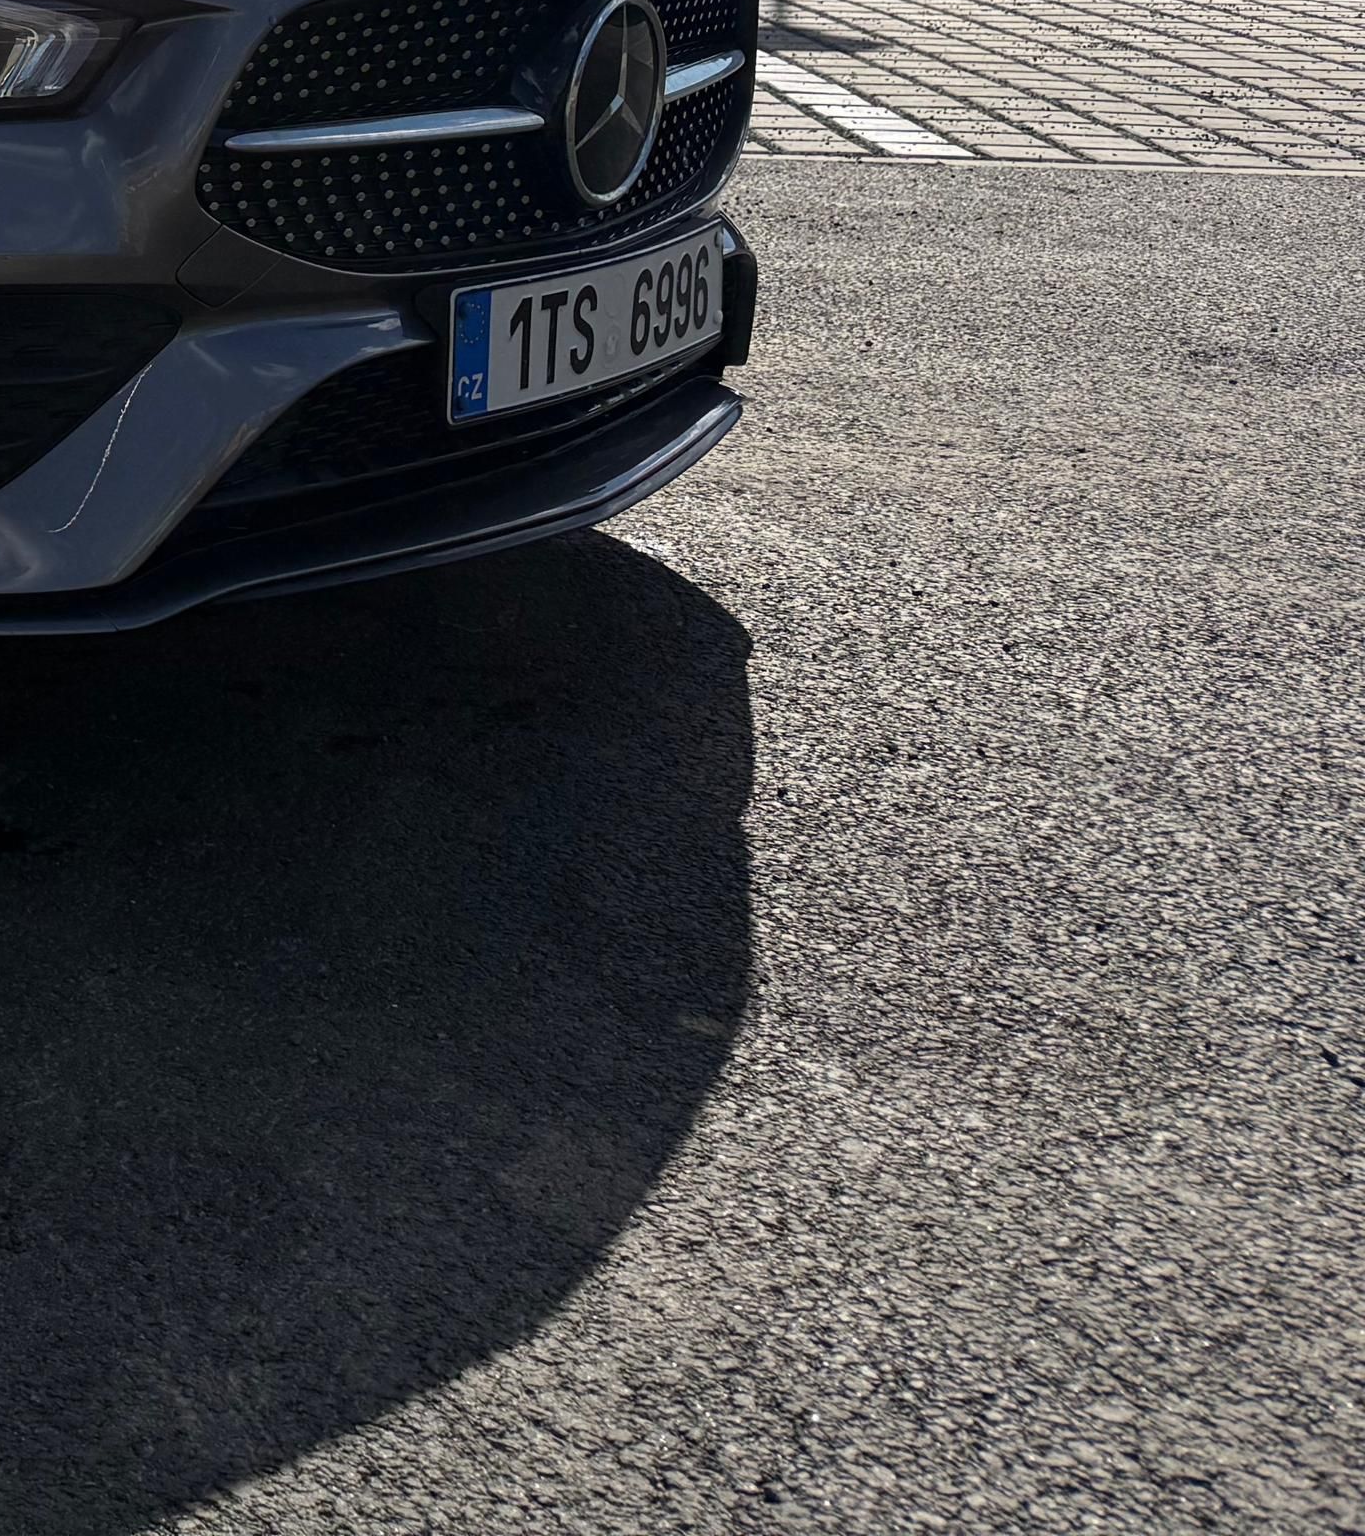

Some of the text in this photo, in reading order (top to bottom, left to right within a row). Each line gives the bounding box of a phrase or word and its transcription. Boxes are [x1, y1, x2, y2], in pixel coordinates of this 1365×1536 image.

[509, 246, 709, 390] 1TS 6996
[457, 372, 483, 401] CZ
